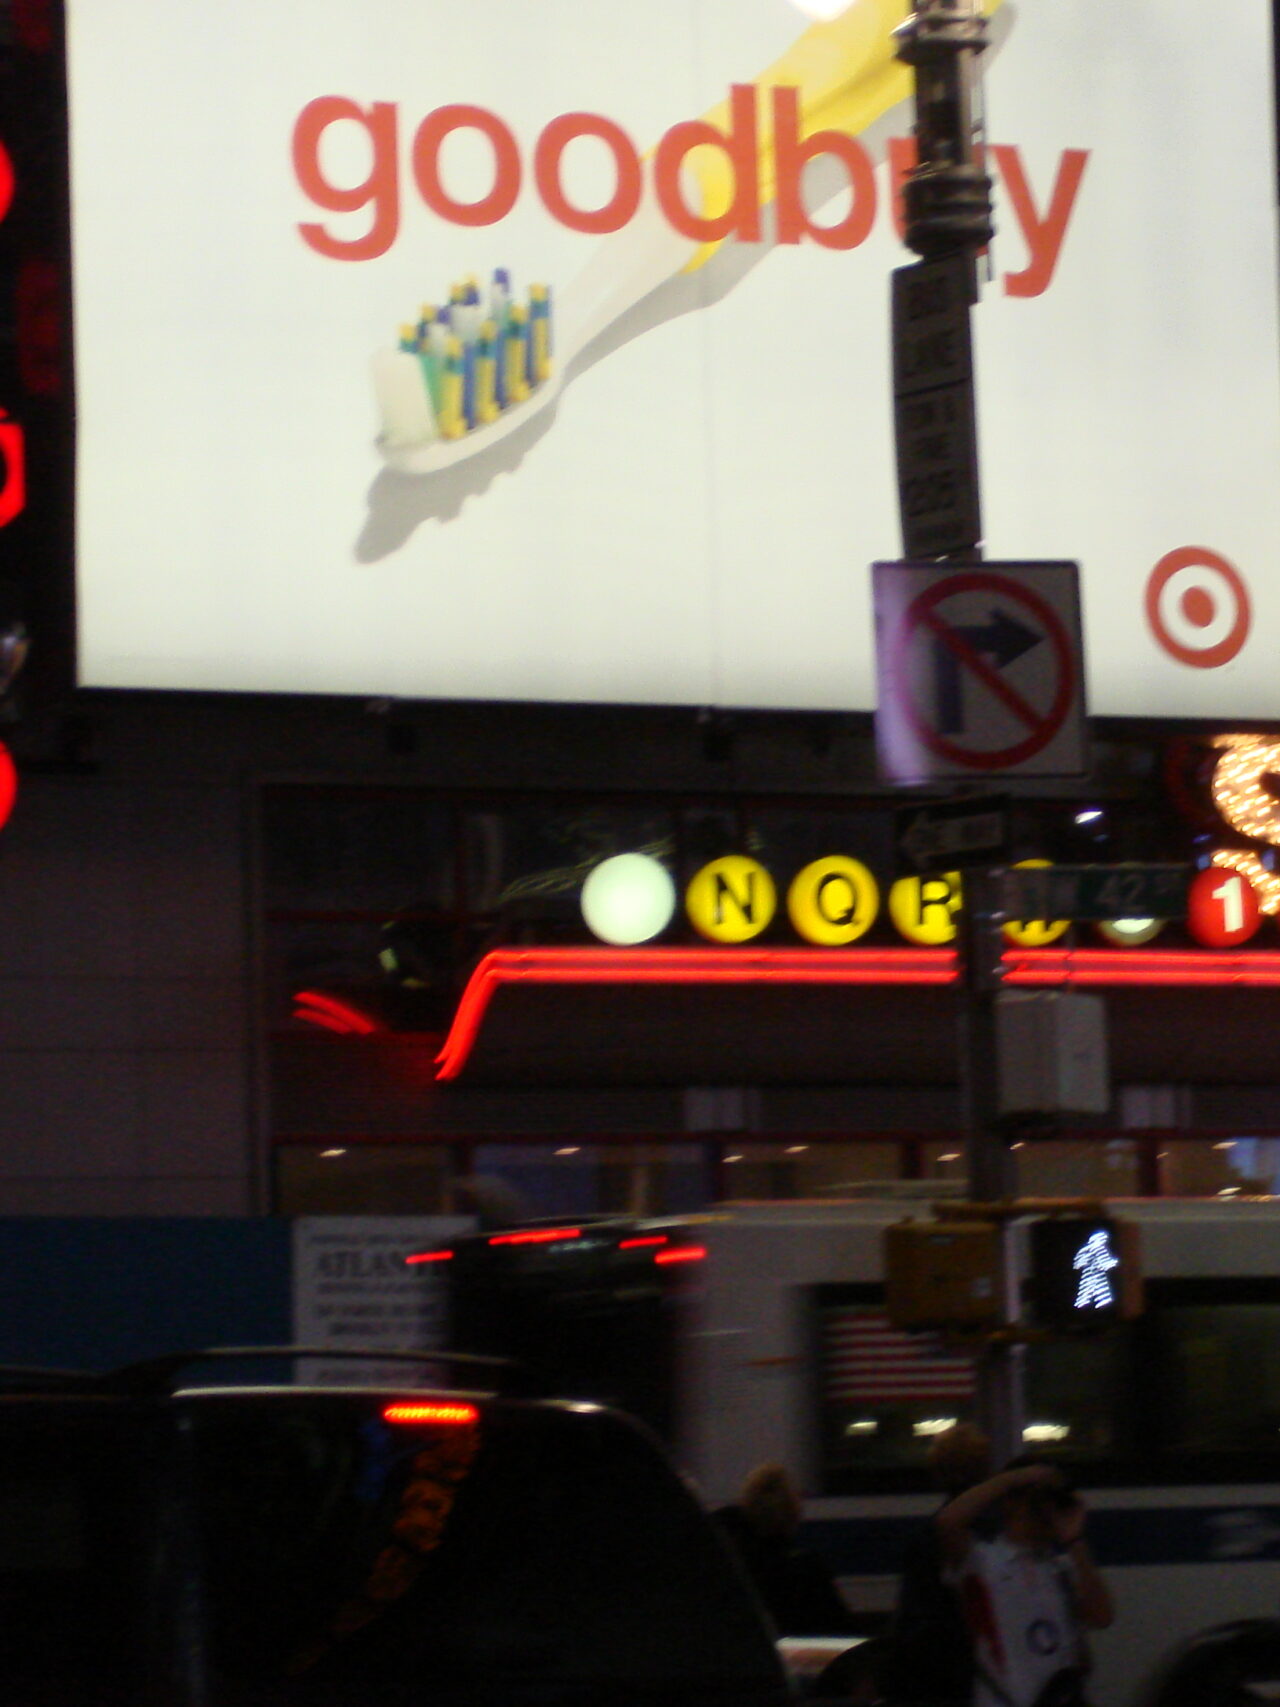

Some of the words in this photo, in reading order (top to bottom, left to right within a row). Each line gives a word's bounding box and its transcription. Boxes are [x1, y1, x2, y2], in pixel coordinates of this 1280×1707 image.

[293, 84, 1087, 297] goodby
[711, 872, 756, 926] N
[816, 871, 860, 928] Q
[917, 873, 960, 929] R
[1212, 876, 1244, 933] 1
[317, 1250, 444, 1279] ATLAN
